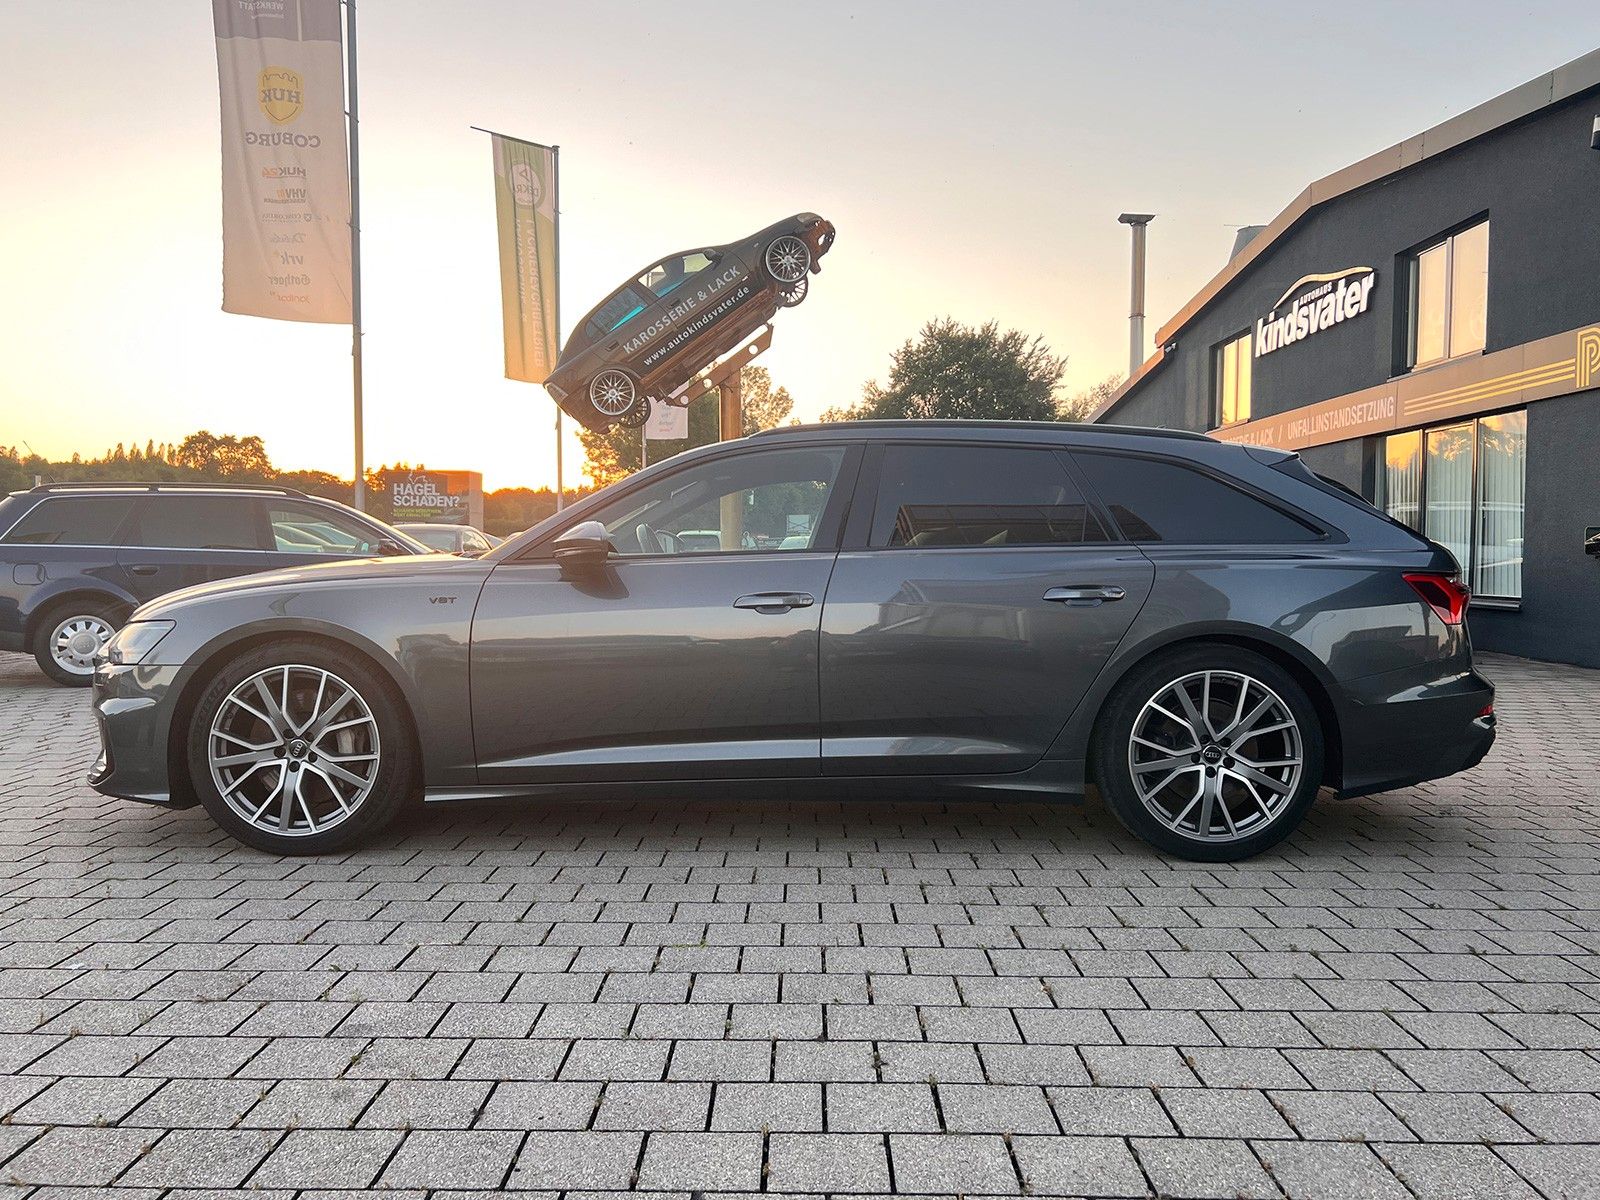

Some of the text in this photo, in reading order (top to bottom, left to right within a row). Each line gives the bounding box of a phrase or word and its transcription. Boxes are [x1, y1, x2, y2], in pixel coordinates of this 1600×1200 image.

[623, 265, 741, 354] KAROSSERIE & LACK
[1254, 272, 1375, 358] kindsvater
[1299, 281, 1333, 306] AUTOHAUS
[643, 286, 750, 366] www.autokindsvater.de
[1287, 396, 1394, 440] UNFALLINSTANDSETZUNG
[393, 483, 440, 495] HAGEL
[393, 496, 460, 507] SCHADEN?
